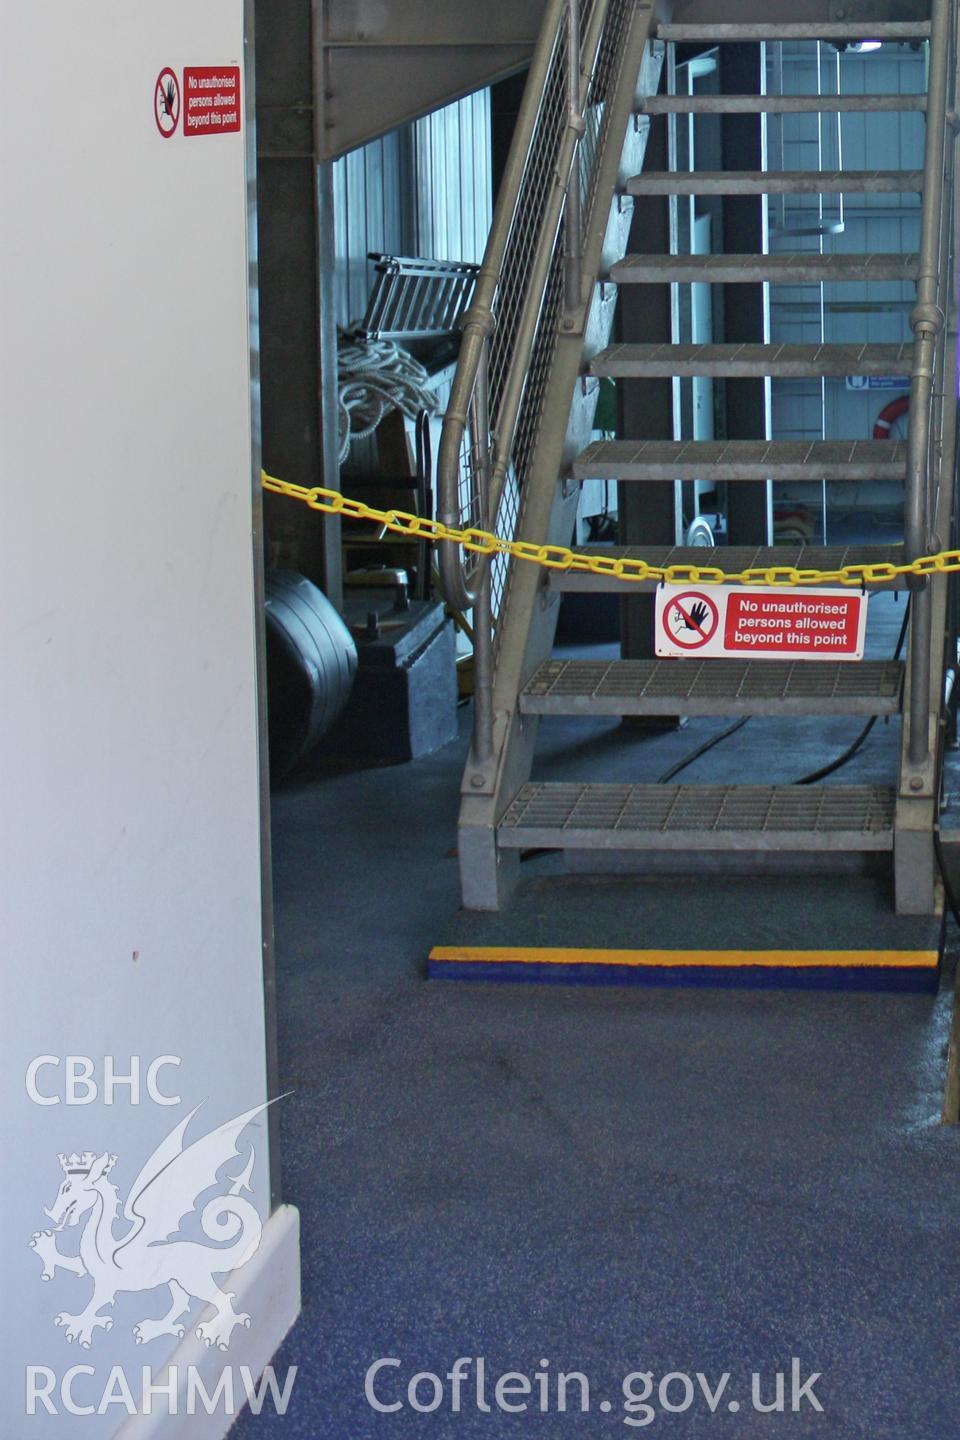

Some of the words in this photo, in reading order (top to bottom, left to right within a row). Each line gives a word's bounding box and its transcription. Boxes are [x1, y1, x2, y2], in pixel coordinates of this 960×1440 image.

[189, 76, 198, 88] No
[198, 75, 236, 89] unauthorised
[189, 97, 213, 110] persons
[213, 93, 235, 106] allowed
[187, 112, 210, 128] beyond
[211, 111, 221, 124] this
[222, 111, 237, 126] point
[739, 600, 758, 612] No
[762, 601, 848, 615] unauthorised
[738, 617, 792, 630] persons
[795, 617, 846, 630] allowed
[734, 631, 783, 646] beyond
[787, 632, 810, 644] this
[813, 634, 848, 648] point
